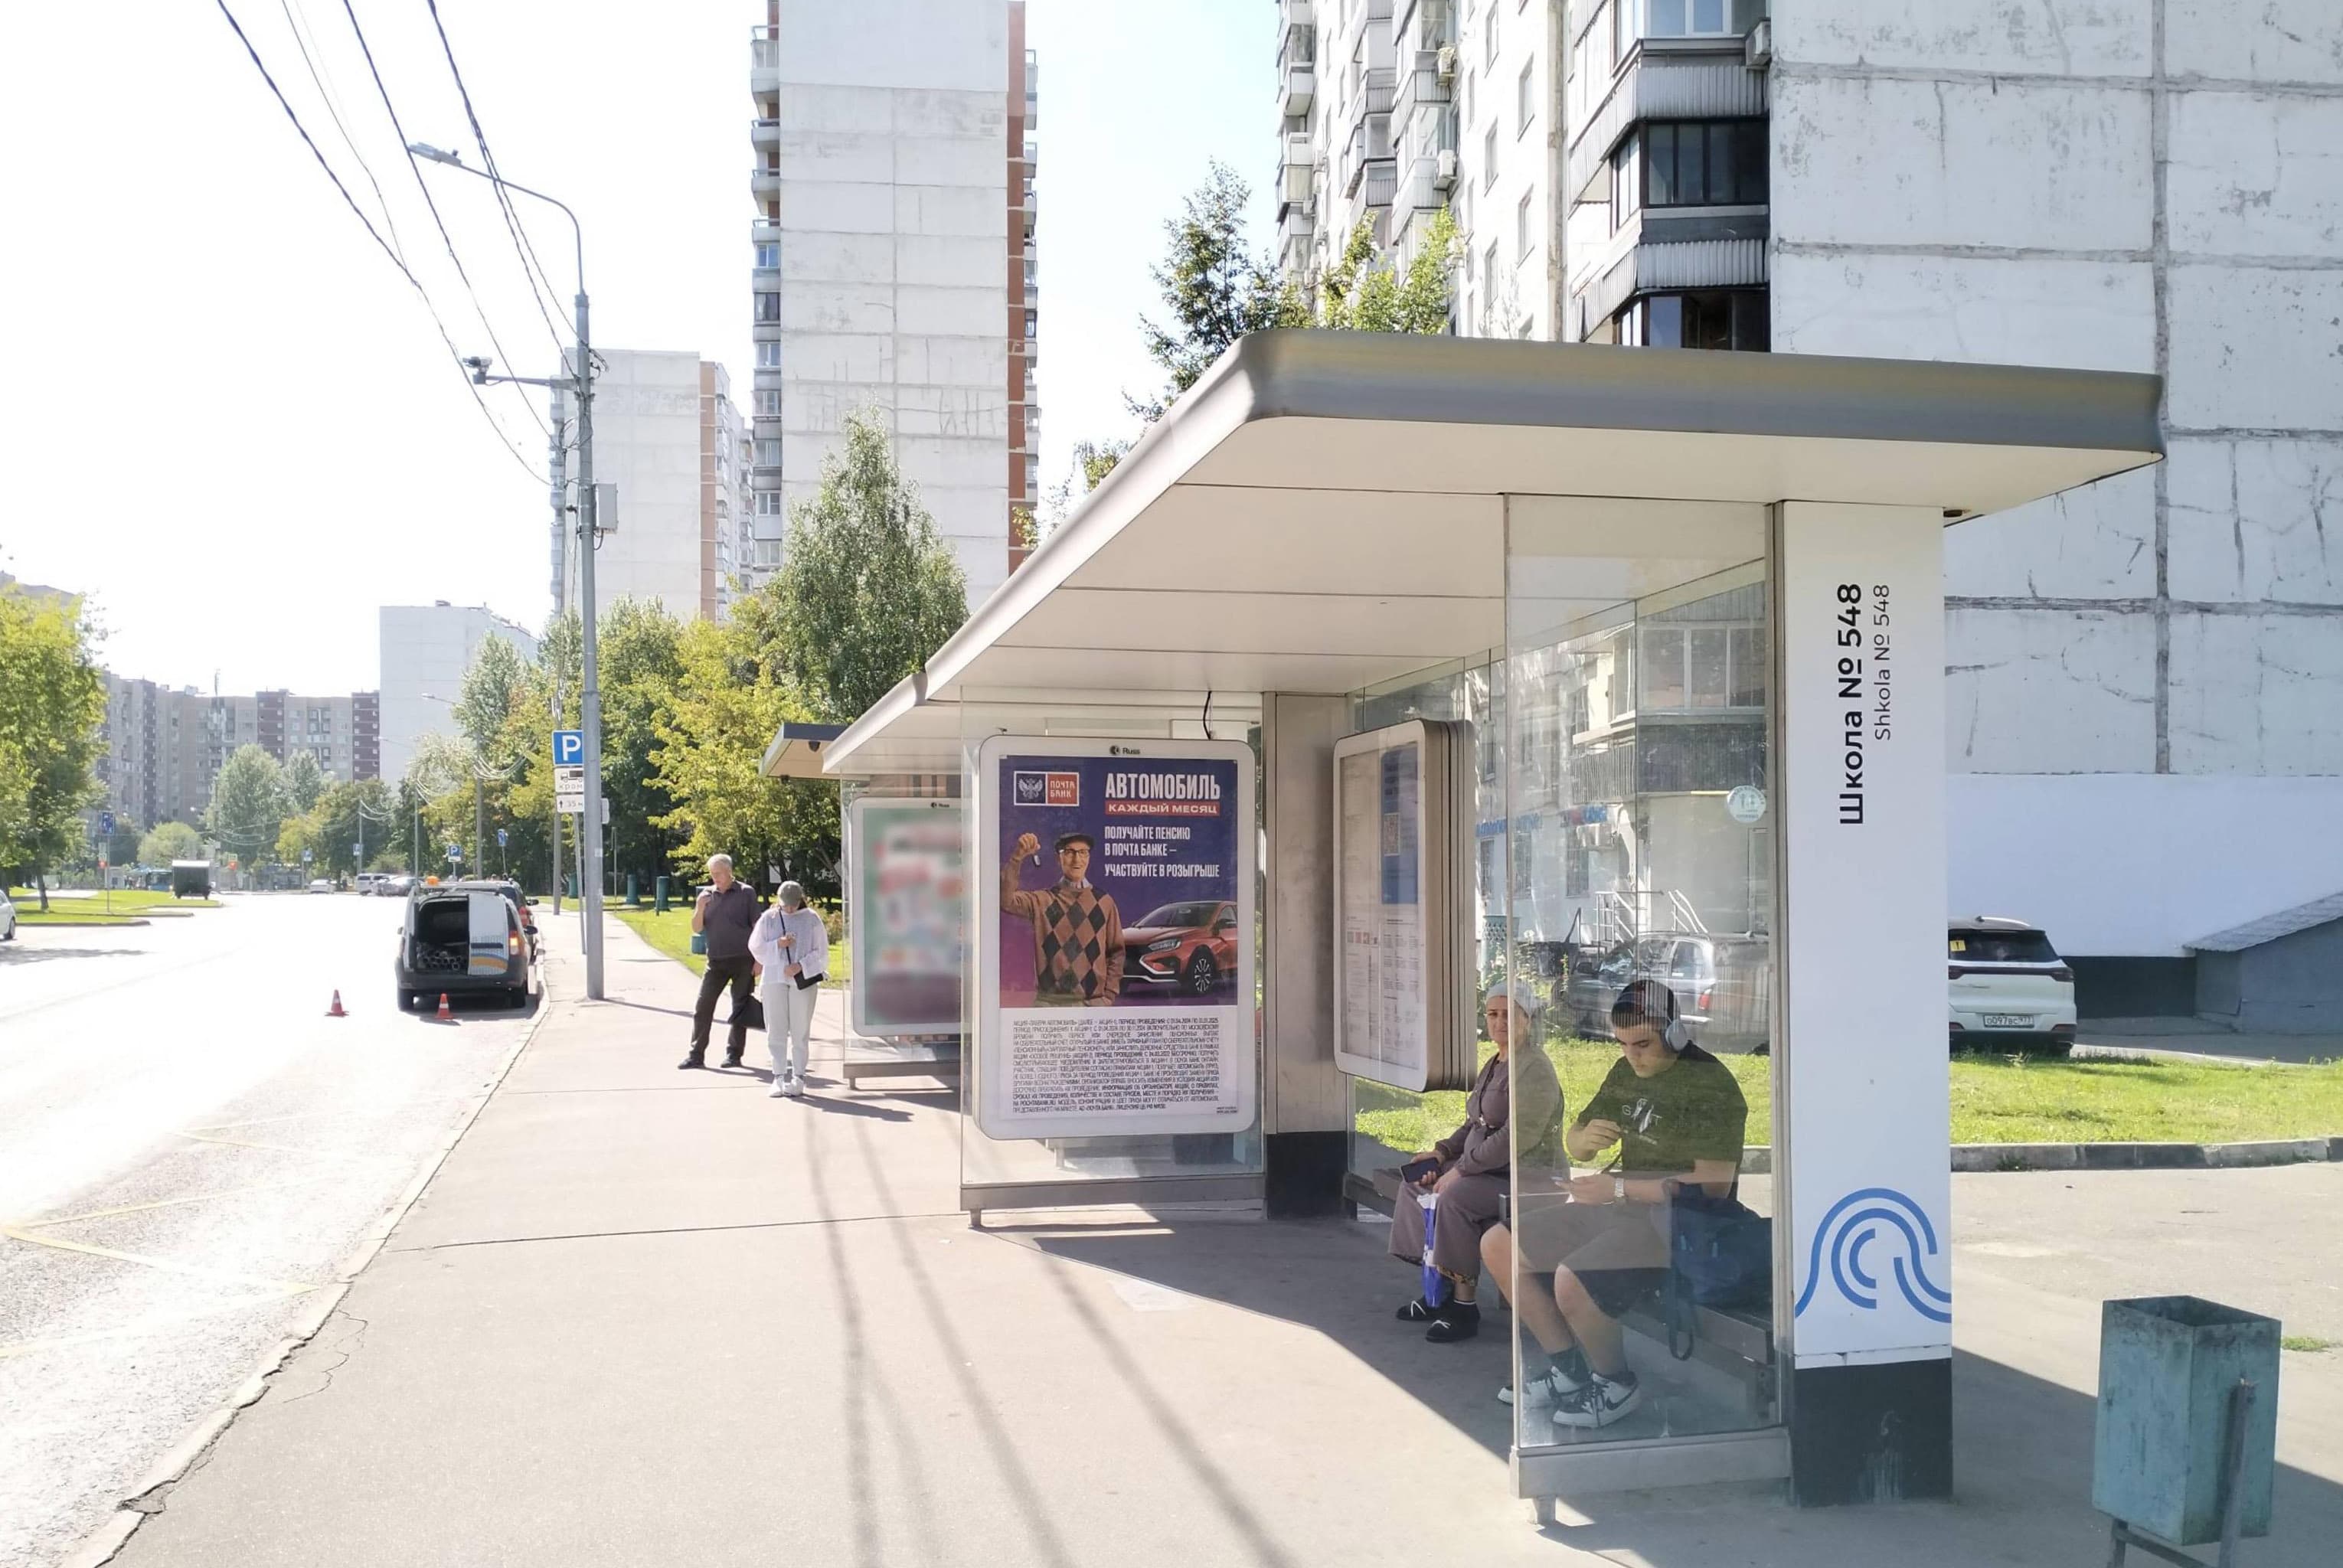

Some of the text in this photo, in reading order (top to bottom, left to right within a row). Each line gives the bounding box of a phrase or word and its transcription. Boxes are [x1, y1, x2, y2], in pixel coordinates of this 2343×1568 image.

[1873, 584, 1891, 741] Shkola № 548
[1837, 583, 1864, 824] Школа № 548
[562, 735, 581, 761] P
[1050, 779, 1076, 790] ПОЧТА
[1105, 772, 1221, 801] АВТОМОБИЛЬ
[1050, 789, 1072, 799] БАНК
[1108, 802, 1218, 815] КАЖДЫЙ МЕСЯЦ
[1104, 825, 1191, 840] ПОЛУЧАЙТЕ ПЕНСИЮ
[1104, 844, 1110, 856] В
[1112, 844, 1139, 857] ПОЧТА
[1141, 844, 1168, 857] БАНКЕ
[1104, 863, 1220, 877] УЧАСТВУЙТЕ В РОЗЫГРЫШЕ
